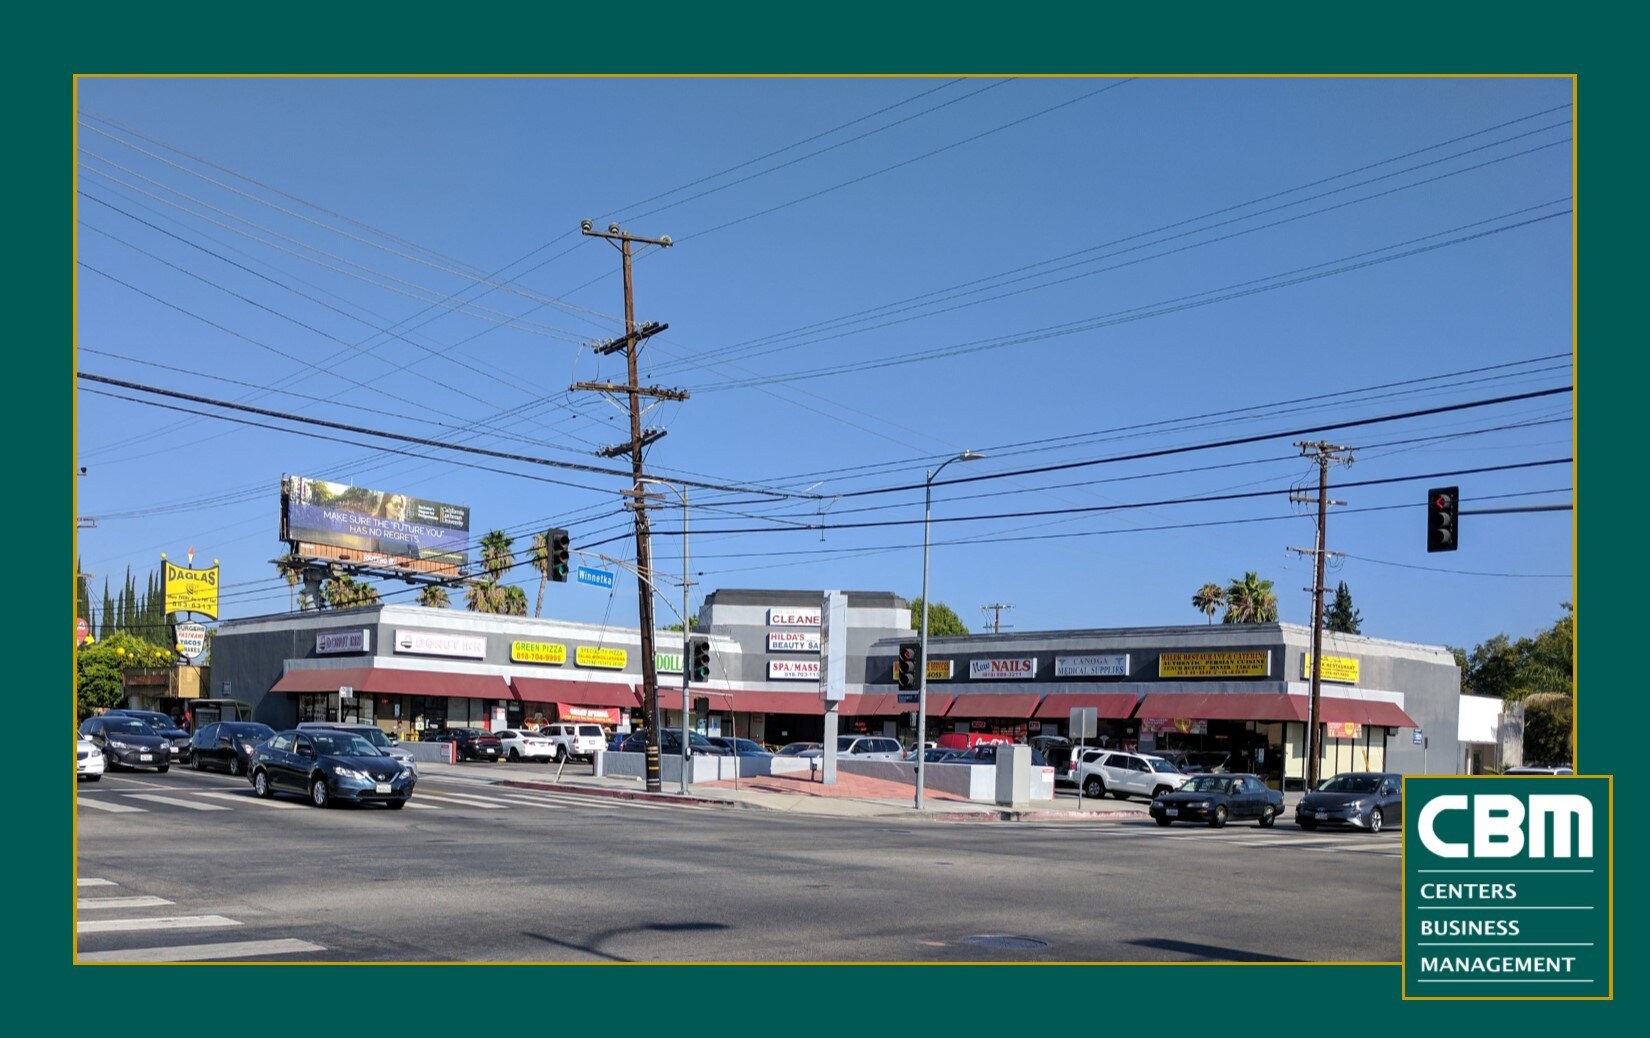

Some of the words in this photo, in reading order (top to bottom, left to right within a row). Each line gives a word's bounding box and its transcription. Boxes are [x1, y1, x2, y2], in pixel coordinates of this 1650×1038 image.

[323, 510, 348, 523] MAKE
[349, 515, 371, 527] SURE
[374, 518, 390, 529] THE
[349, 525, 368, 535] HAS
[369, 527, 382, 537] NO
[579, 569, 612, 585] Winnetka
[772, 614, 820, 624] CLEANE
[177, 624, 205, 632] BURGERS
[178, 631, 204, 640] PASTRAMI
[326, 633, 349, 649] DONUT
[350, 632, 362, 648] INN
[771, 633, 805, 641] HILDA'S
[180, 638, 202, 646] TACOS
[416, 636, 460, 650] DONUT
[462, 640, 482, 652] INN
[772, 641, 805, 649] BEAUTY
[808, 641, 819, 649] SA
[515, 641, 541, 653] GREEN
[542, 643, 563, 654] PIZZA
[516, 652, 562, 662] 818-704-9999
[1073, 657, 1108, 665] CANOGA
[1184, 653, 1225, 661] RESTAURANT
[1234, 652, 1266, 660] CATERING
[656, 654, 683, 671] DOLL
[773, 662, 820, 672] SPA/MASS
[972, 661, 990, 674] New
[991, 660, 1031, 672] NAILS
[1058, 666, 1088, 674] MEDICAL
[1090, 665, 1124, 674] SUPPLIES
